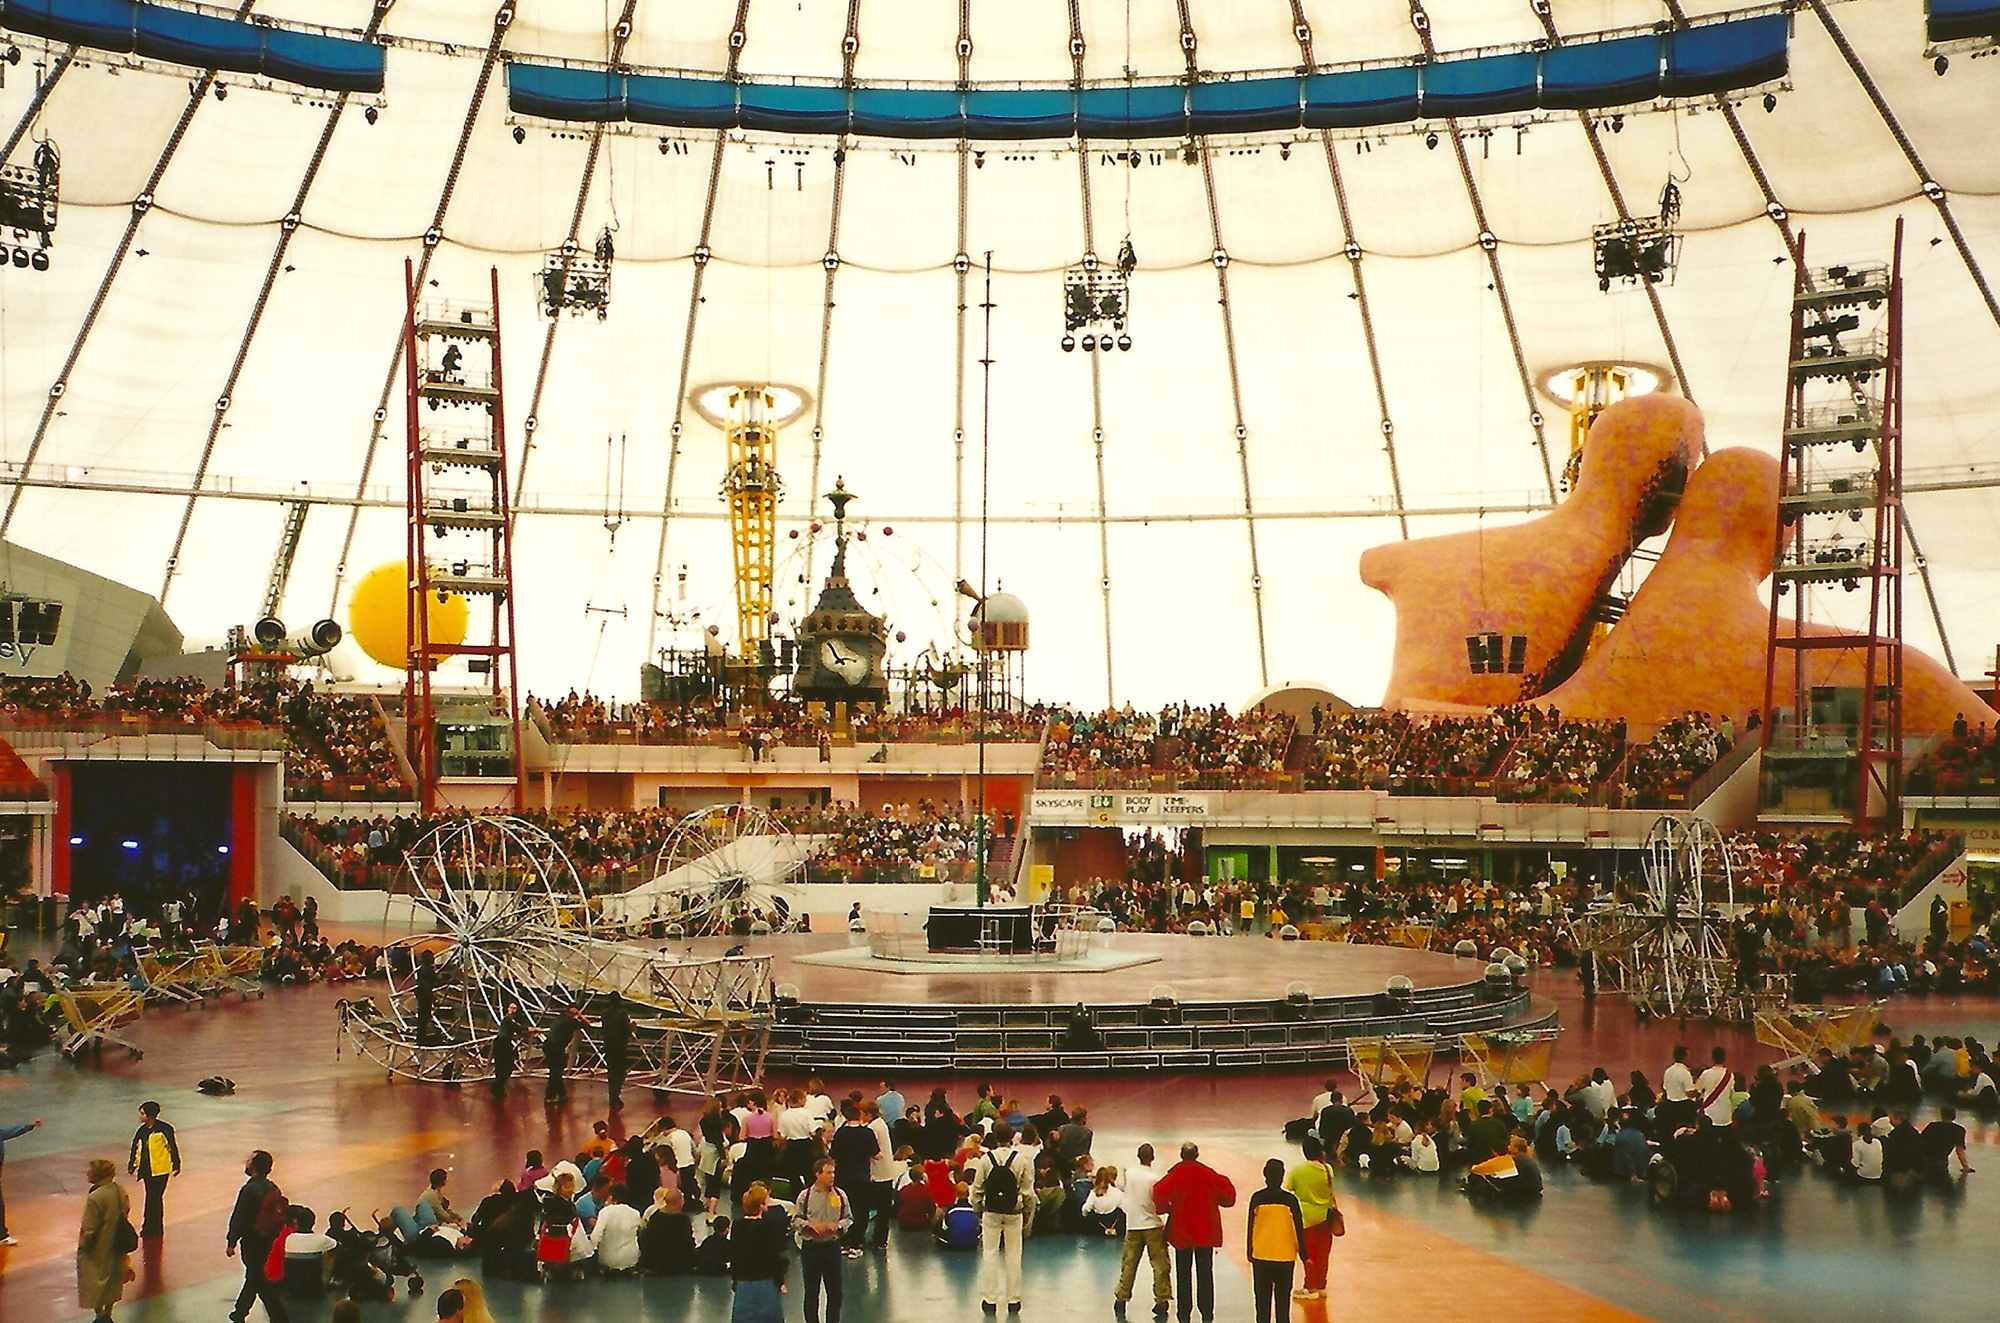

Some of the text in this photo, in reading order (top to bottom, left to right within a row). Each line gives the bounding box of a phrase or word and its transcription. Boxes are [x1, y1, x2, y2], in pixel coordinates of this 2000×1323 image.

[1036, 799, 1084, 808] SKYSCAPE
[1126, 796, 1152, 805] BODY
[1126, 806, 1150, 814] PLAY
[1163, 806, 1205, 814] KEEPERS
[1099, 813, 1109, 822] G
[1970, 829, 1990, 840] CD
